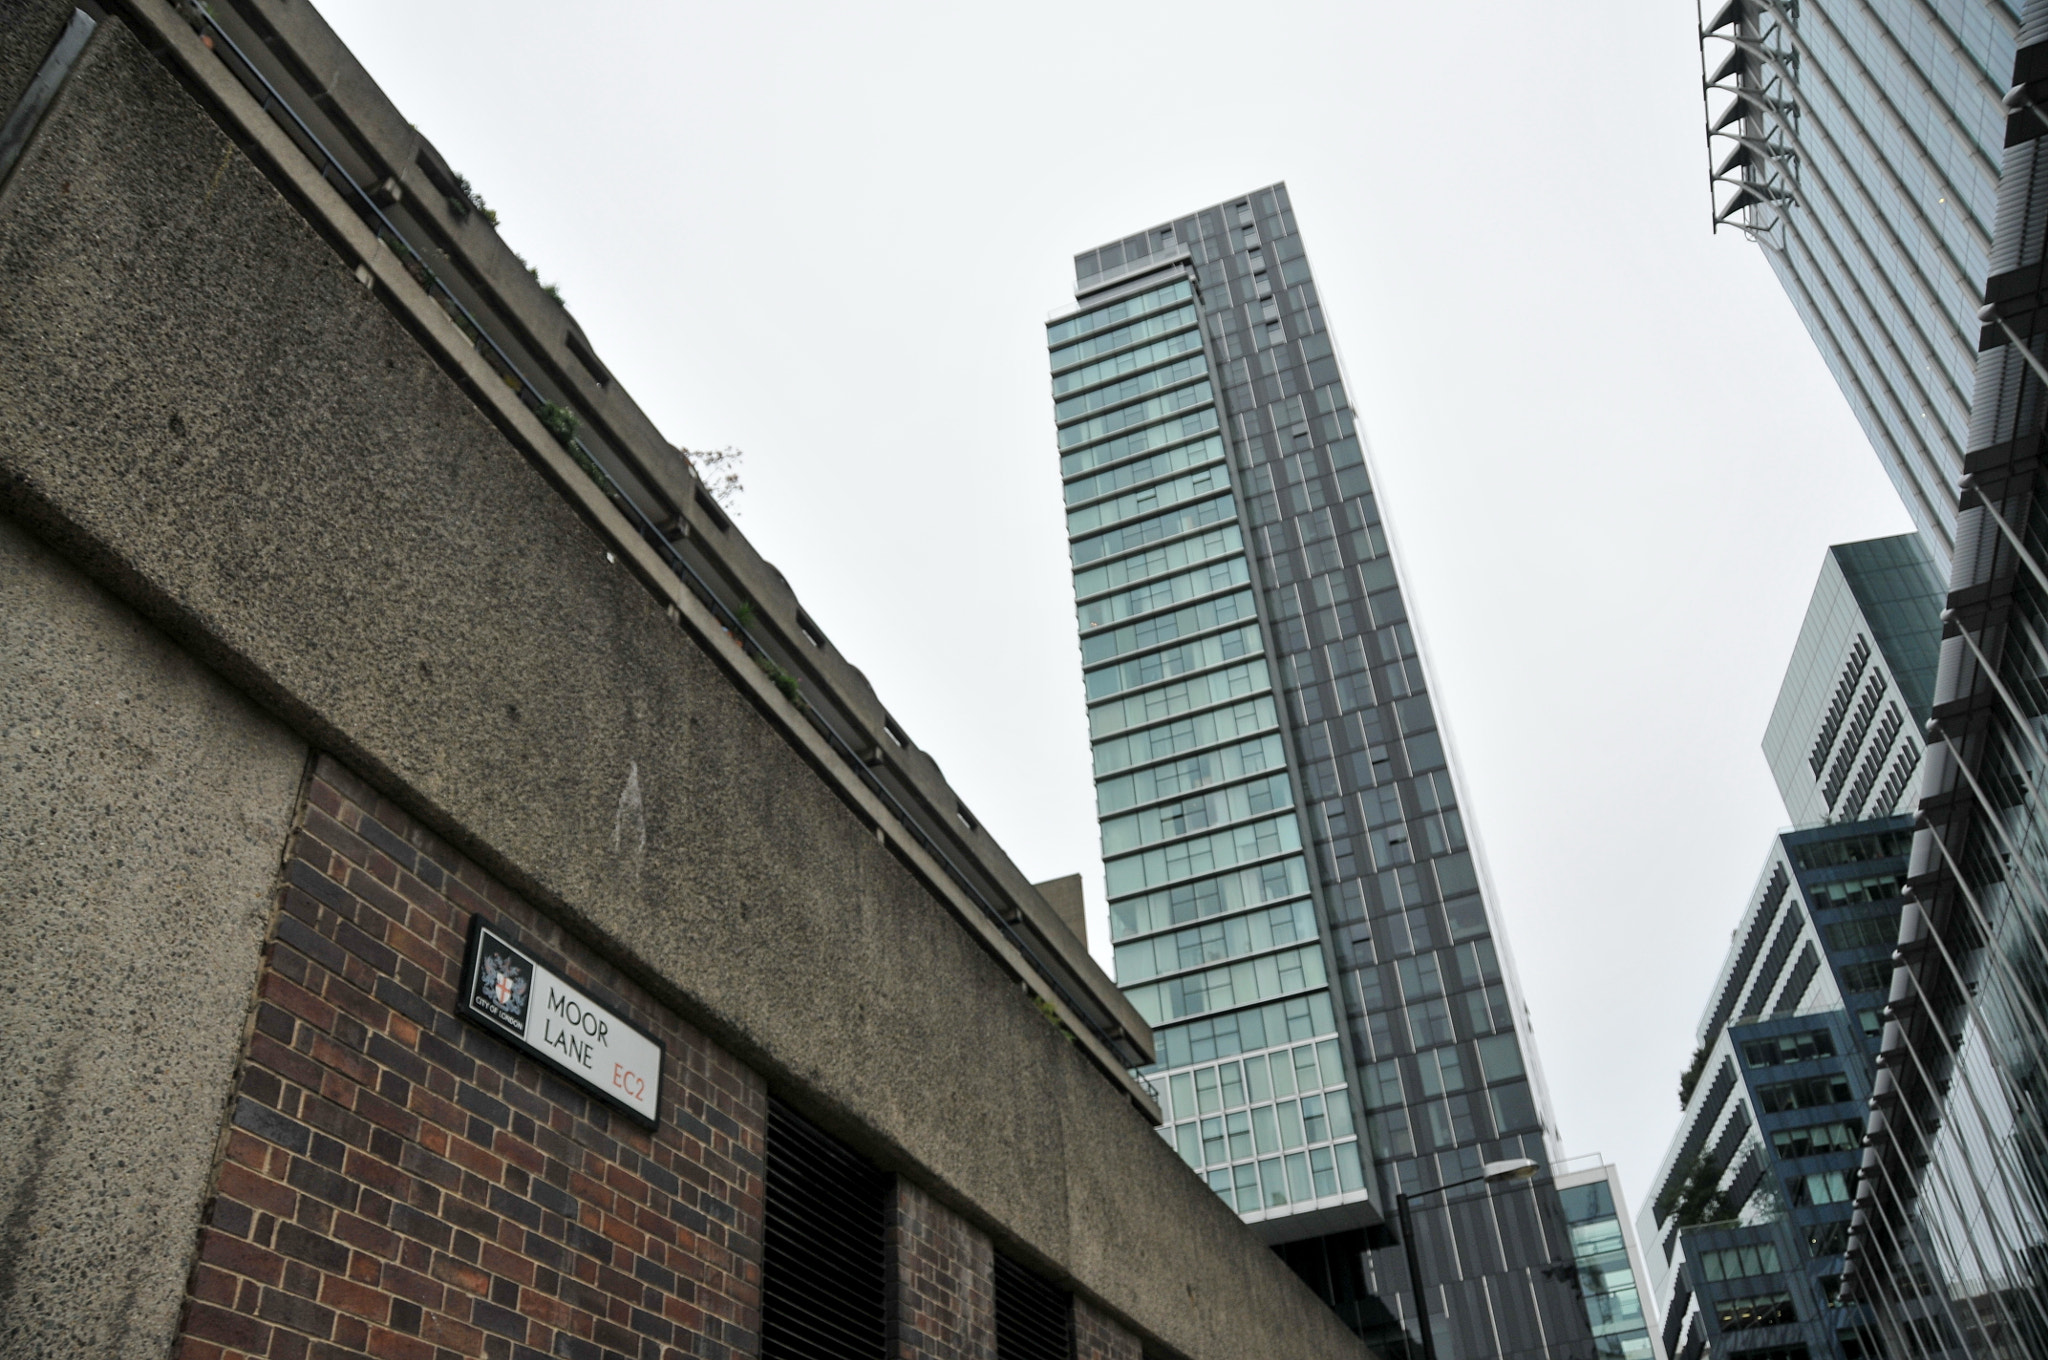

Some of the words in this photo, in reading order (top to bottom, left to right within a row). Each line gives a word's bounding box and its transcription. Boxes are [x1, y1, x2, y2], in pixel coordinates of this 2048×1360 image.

[475, 996, 490, 1009] CITY
[489, 1005, 498, 1014] OF
[499, 1010, 523, 1030] LONDON
[547, 987, 608, 1048] MOOR
[544, 1019, 593, 1069] LANE
[612, 1062, 646, 1101] EC2
